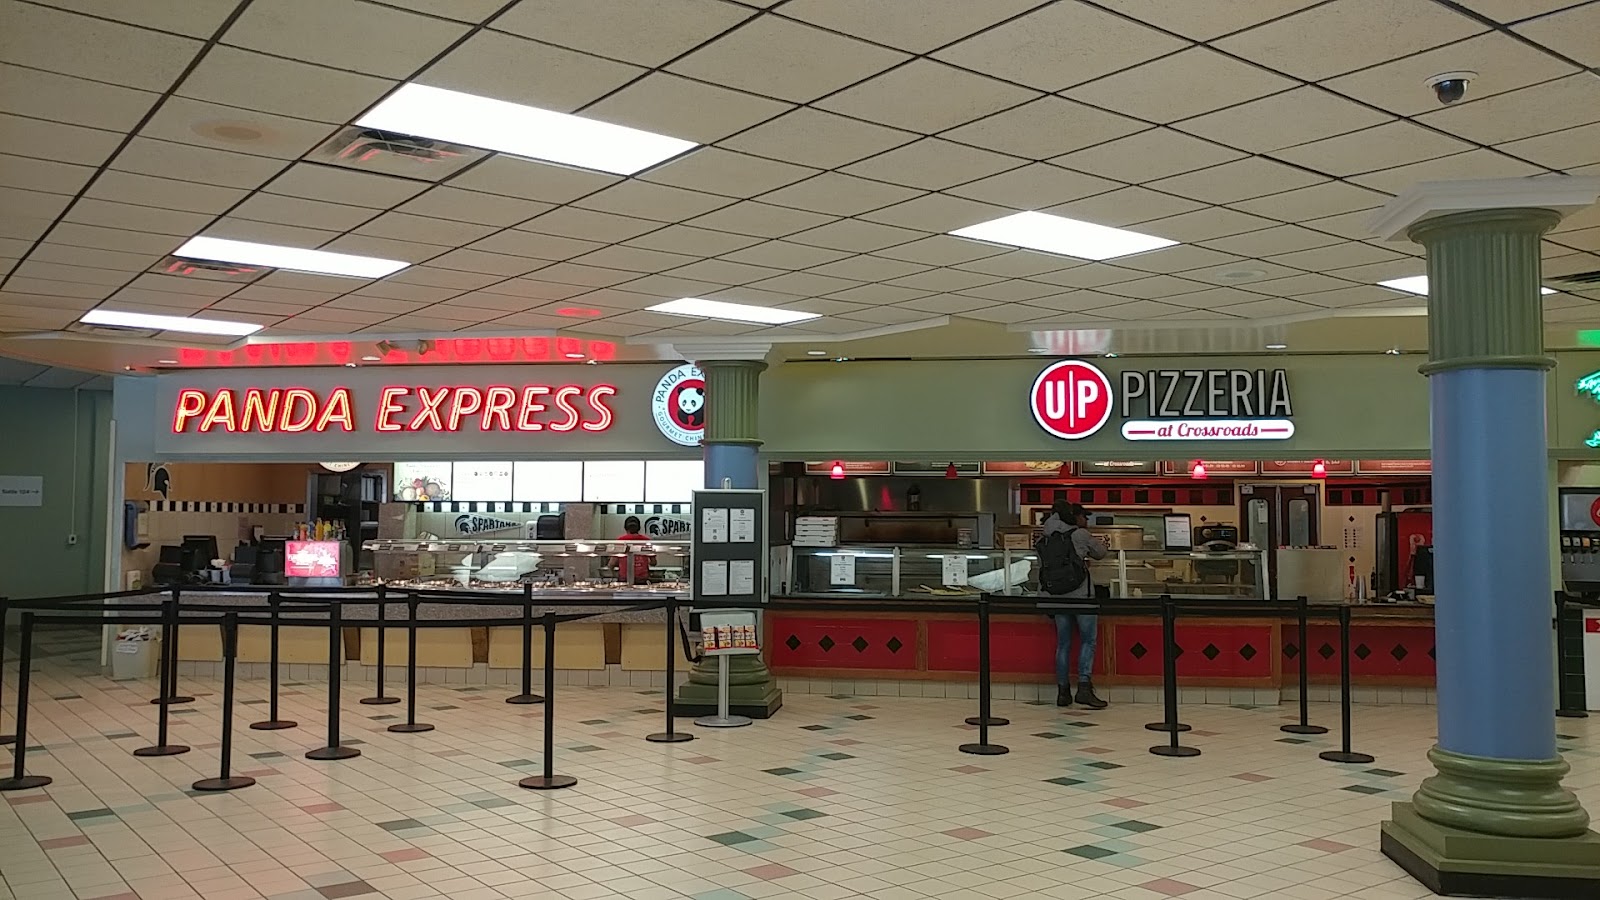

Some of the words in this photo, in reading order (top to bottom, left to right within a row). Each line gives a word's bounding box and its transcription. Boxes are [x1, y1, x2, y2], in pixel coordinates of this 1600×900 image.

[656, 369, 686, 403] PANDA
[1120, 369, 1293, 418] PIZZERIA
[174, 387, 355, 433] PANDA
[376, 385, 619, 433] EXPRESS
[658, 411, 682, 439] GOURMET
[1157, 424, 1173, 437] at
[1177, 422, 1259, 438] Crossroads
